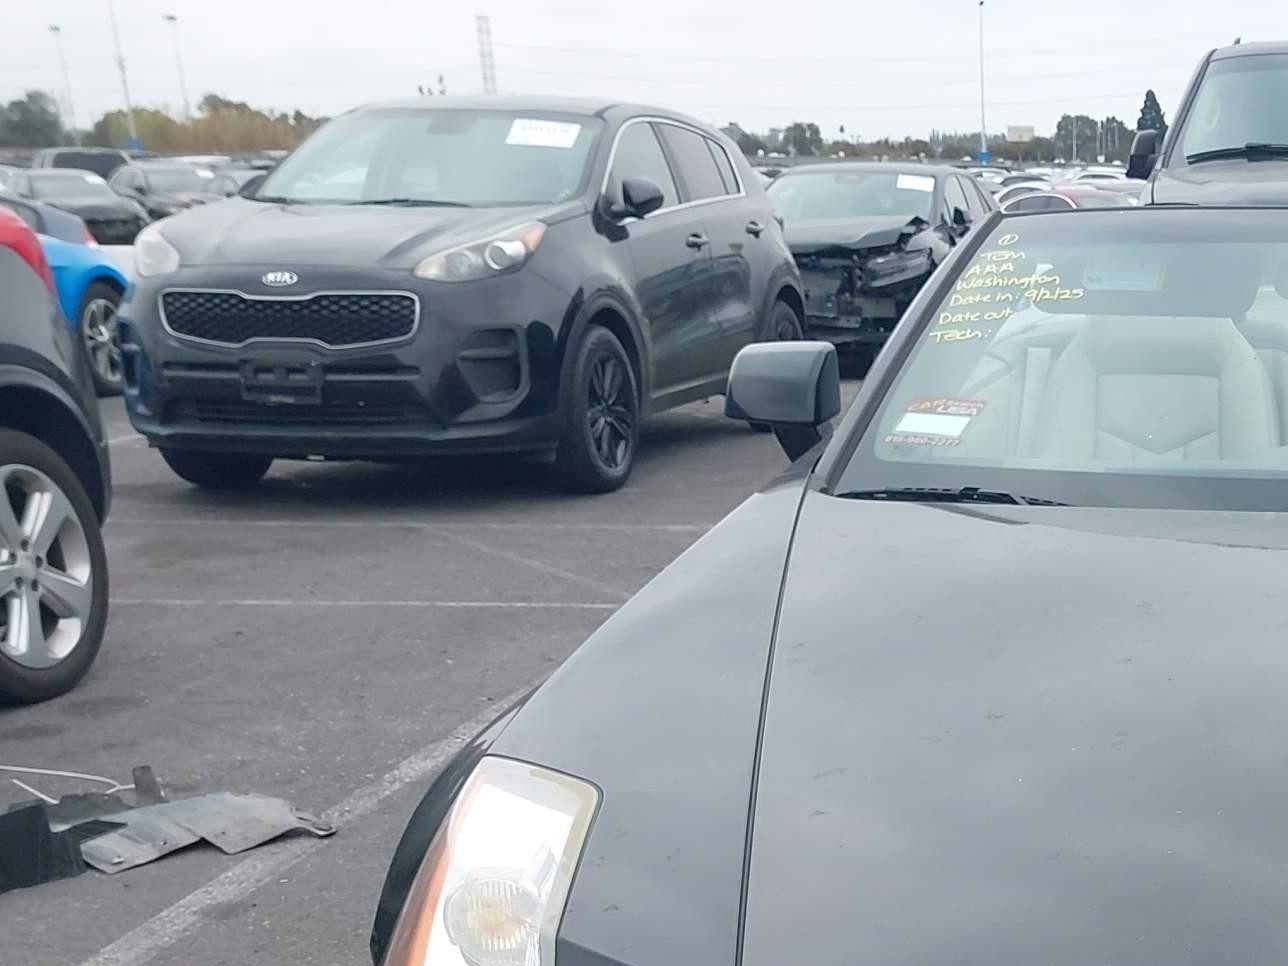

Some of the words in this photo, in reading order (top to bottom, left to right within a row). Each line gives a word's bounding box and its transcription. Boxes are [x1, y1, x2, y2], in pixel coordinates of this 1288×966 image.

[965, 263, 1014, 278] AAA
[956, 274, 1060, 291] Washington
[950, 293, 992, 307] Date
[1025, 288, 1084, 301] 9/2/25
[939, 311, 980, 325] Date
